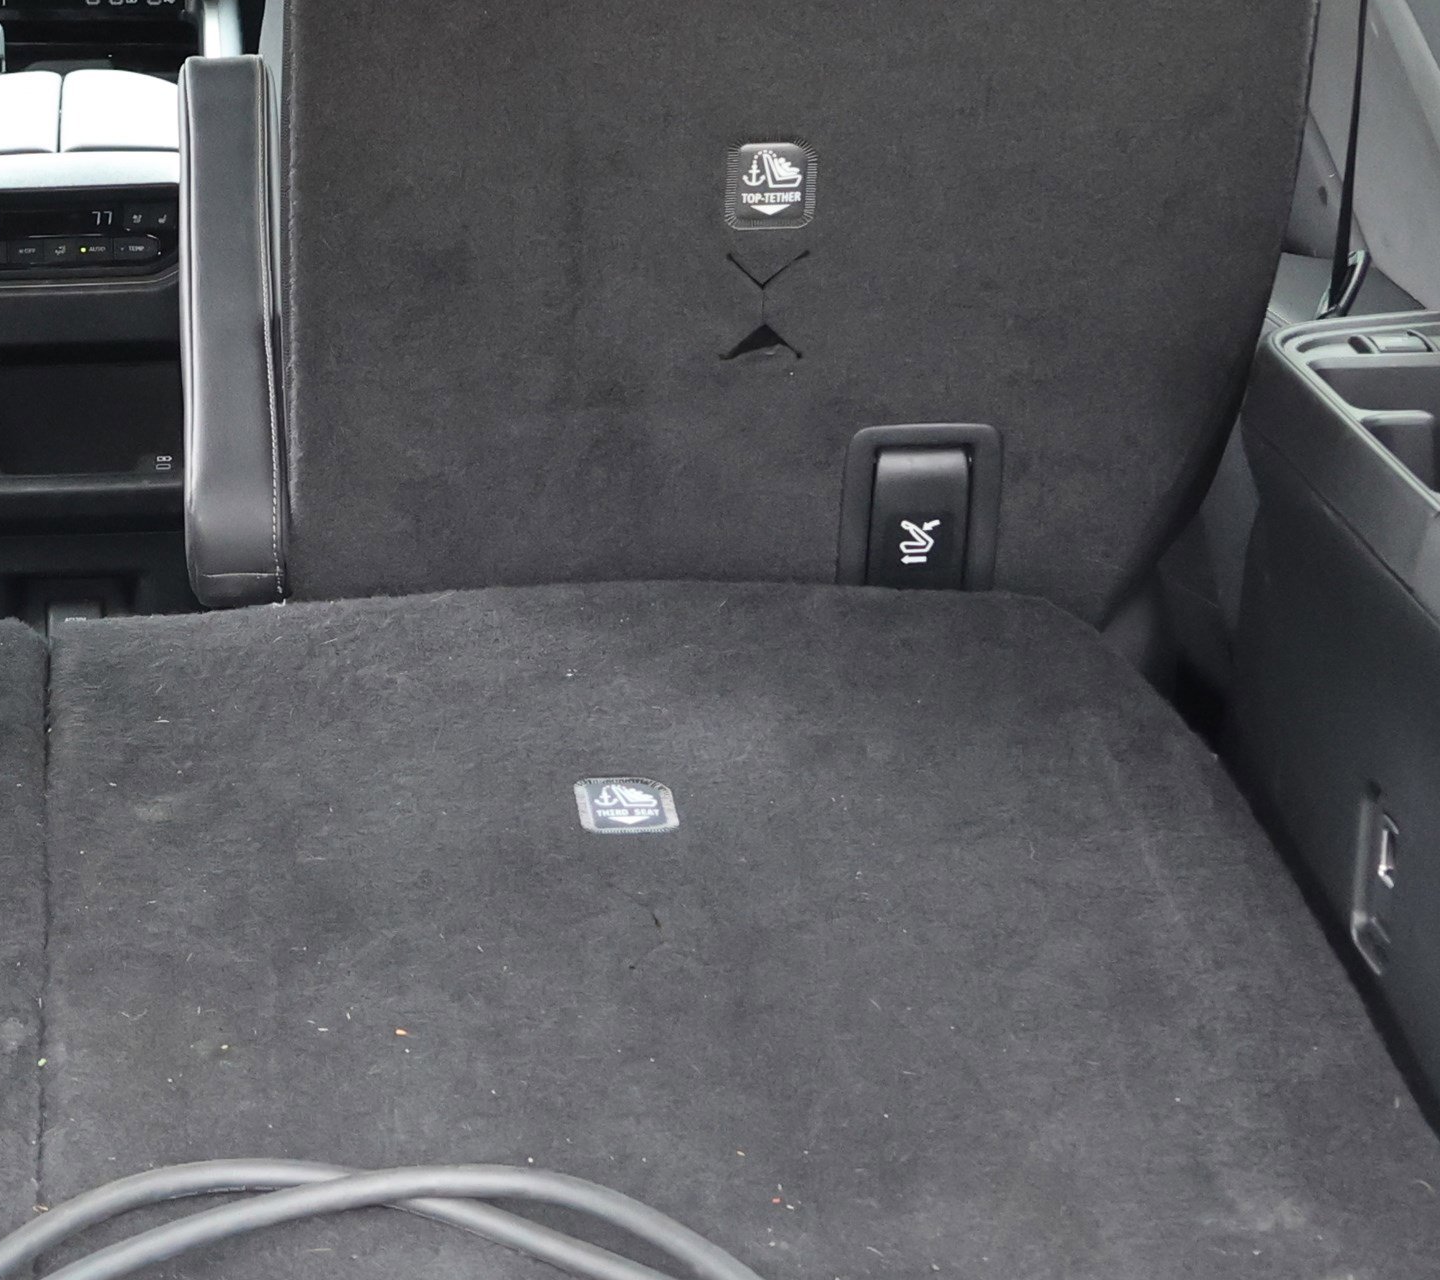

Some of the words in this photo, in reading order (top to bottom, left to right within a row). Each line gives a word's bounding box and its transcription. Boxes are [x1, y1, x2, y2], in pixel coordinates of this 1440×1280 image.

[741, 191, 802, 204] TOP-TETHER
[91, 210, 113, 226] 77
[595, 808, 629, 817] THIRD
[634, 808, 660, 817] SEAT
